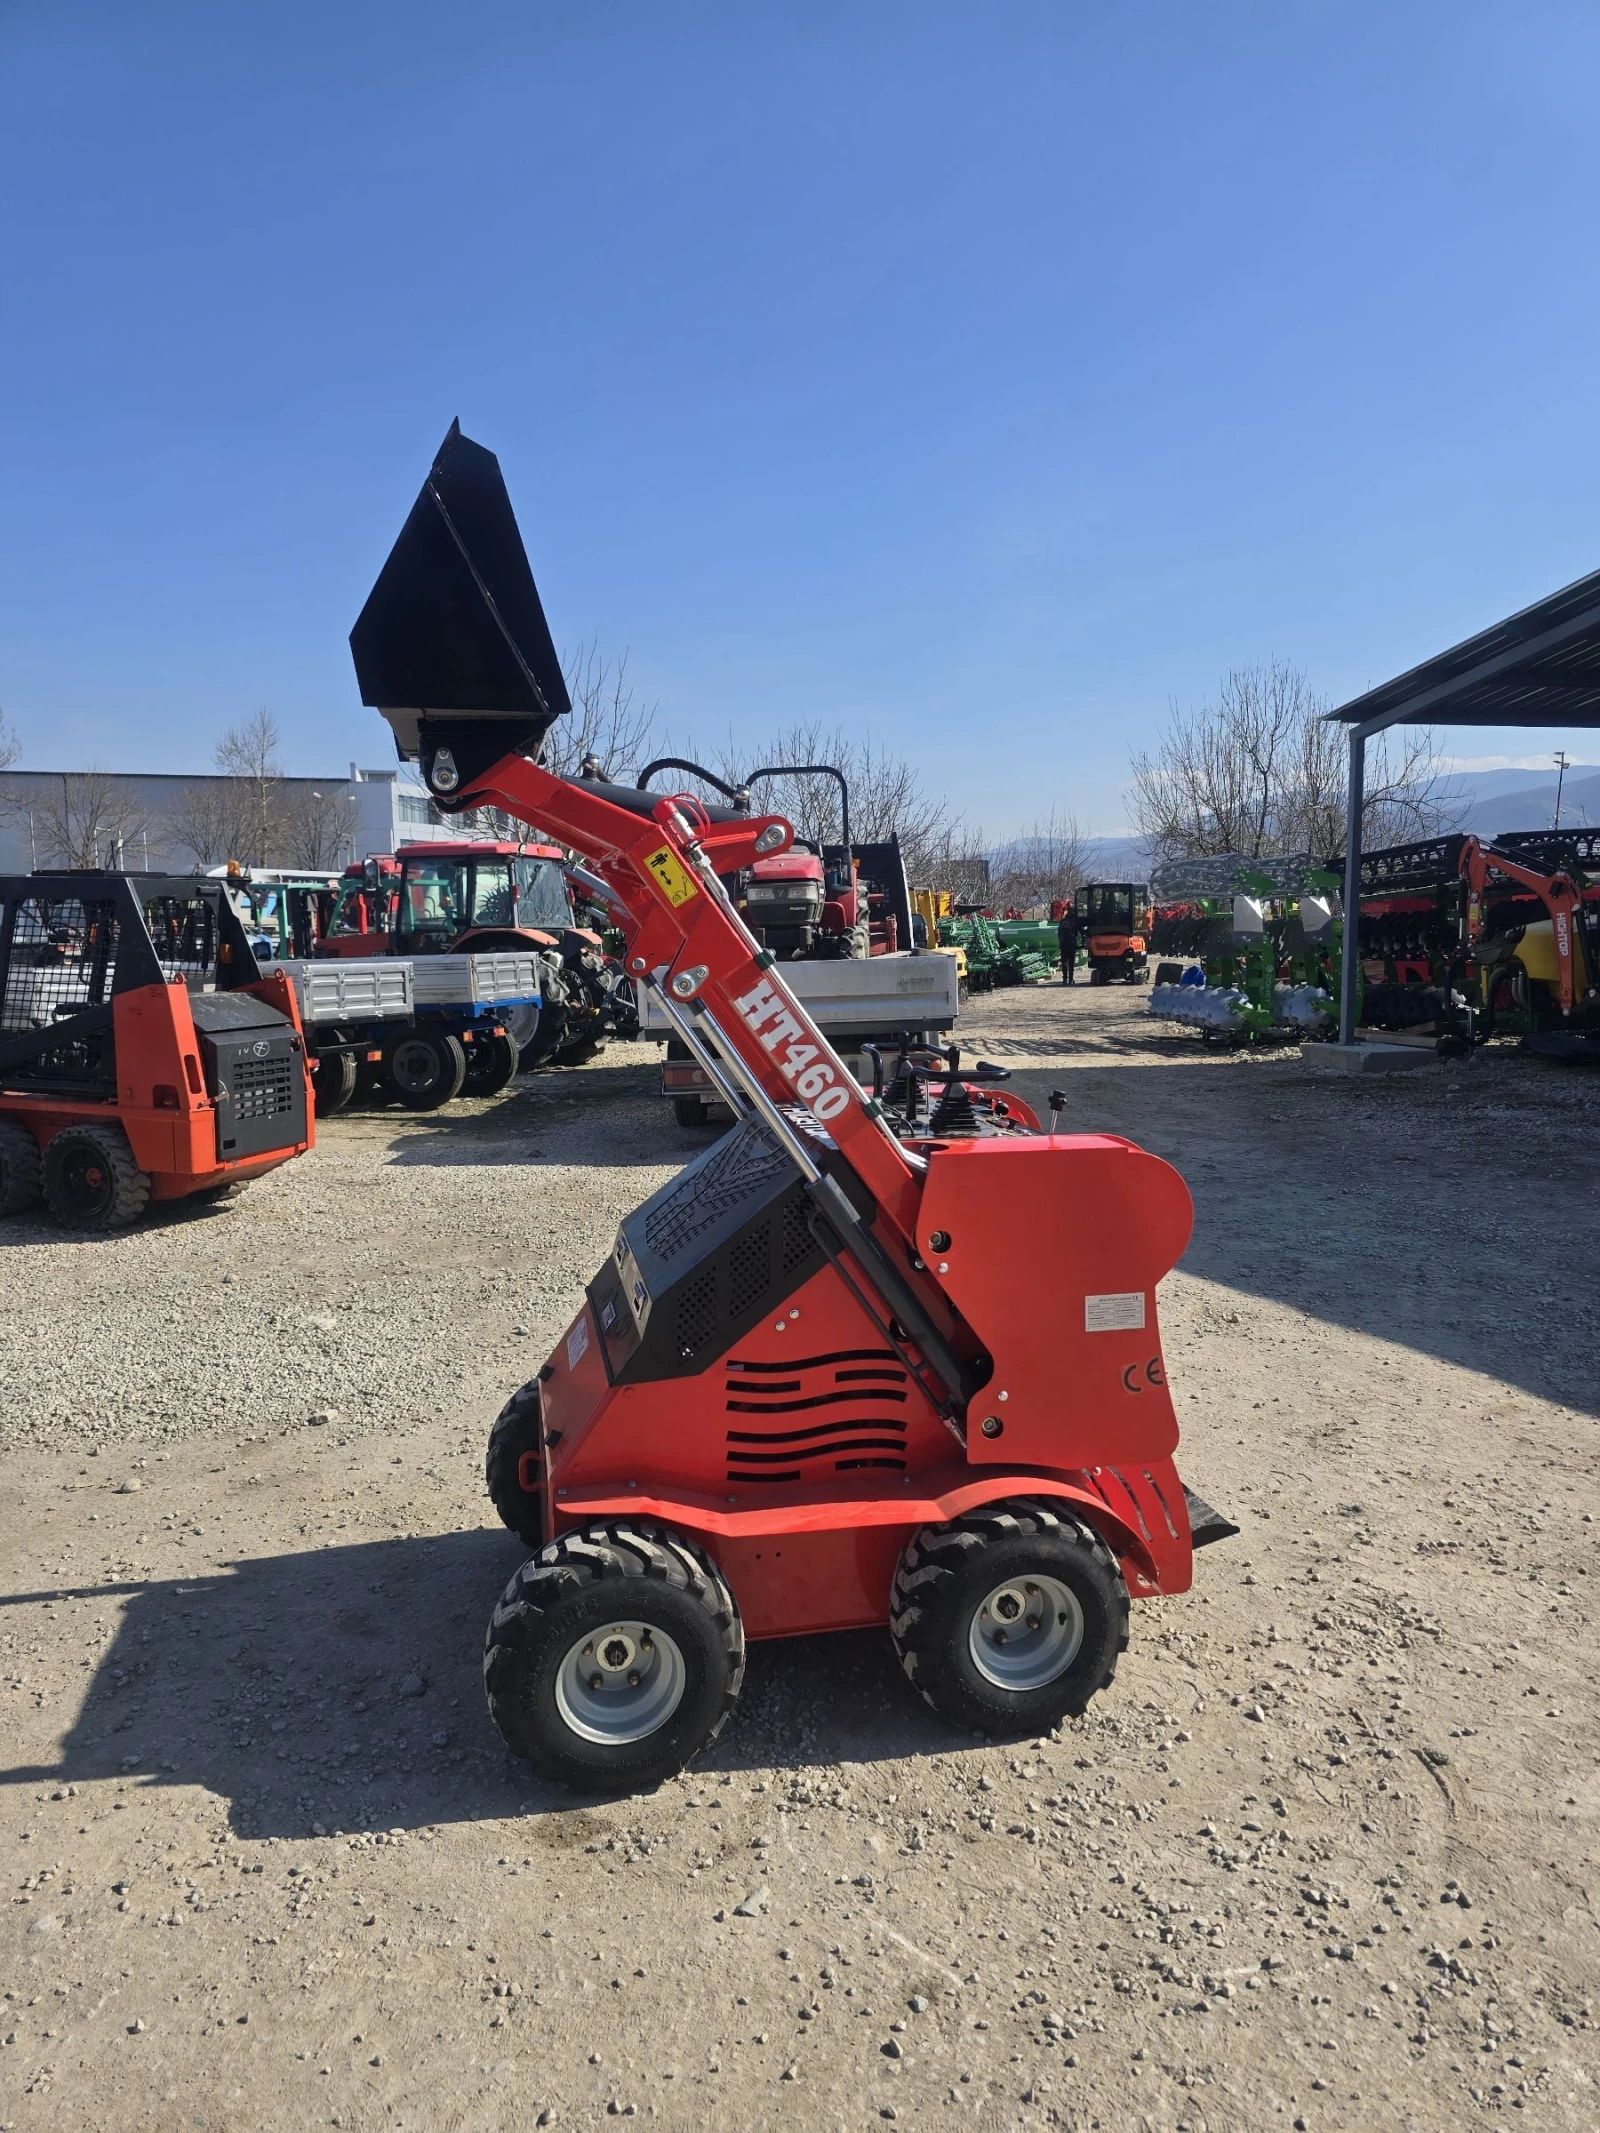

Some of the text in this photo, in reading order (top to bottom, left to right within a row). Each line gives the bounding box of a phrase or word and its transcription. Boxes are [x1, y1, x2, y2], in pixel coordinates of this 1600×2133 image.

[1556, 912, 1569, 956] HIGHTOP
[733, 979, 850, 1120] HT460
[1123, 1357, 1164, 1393] CE
